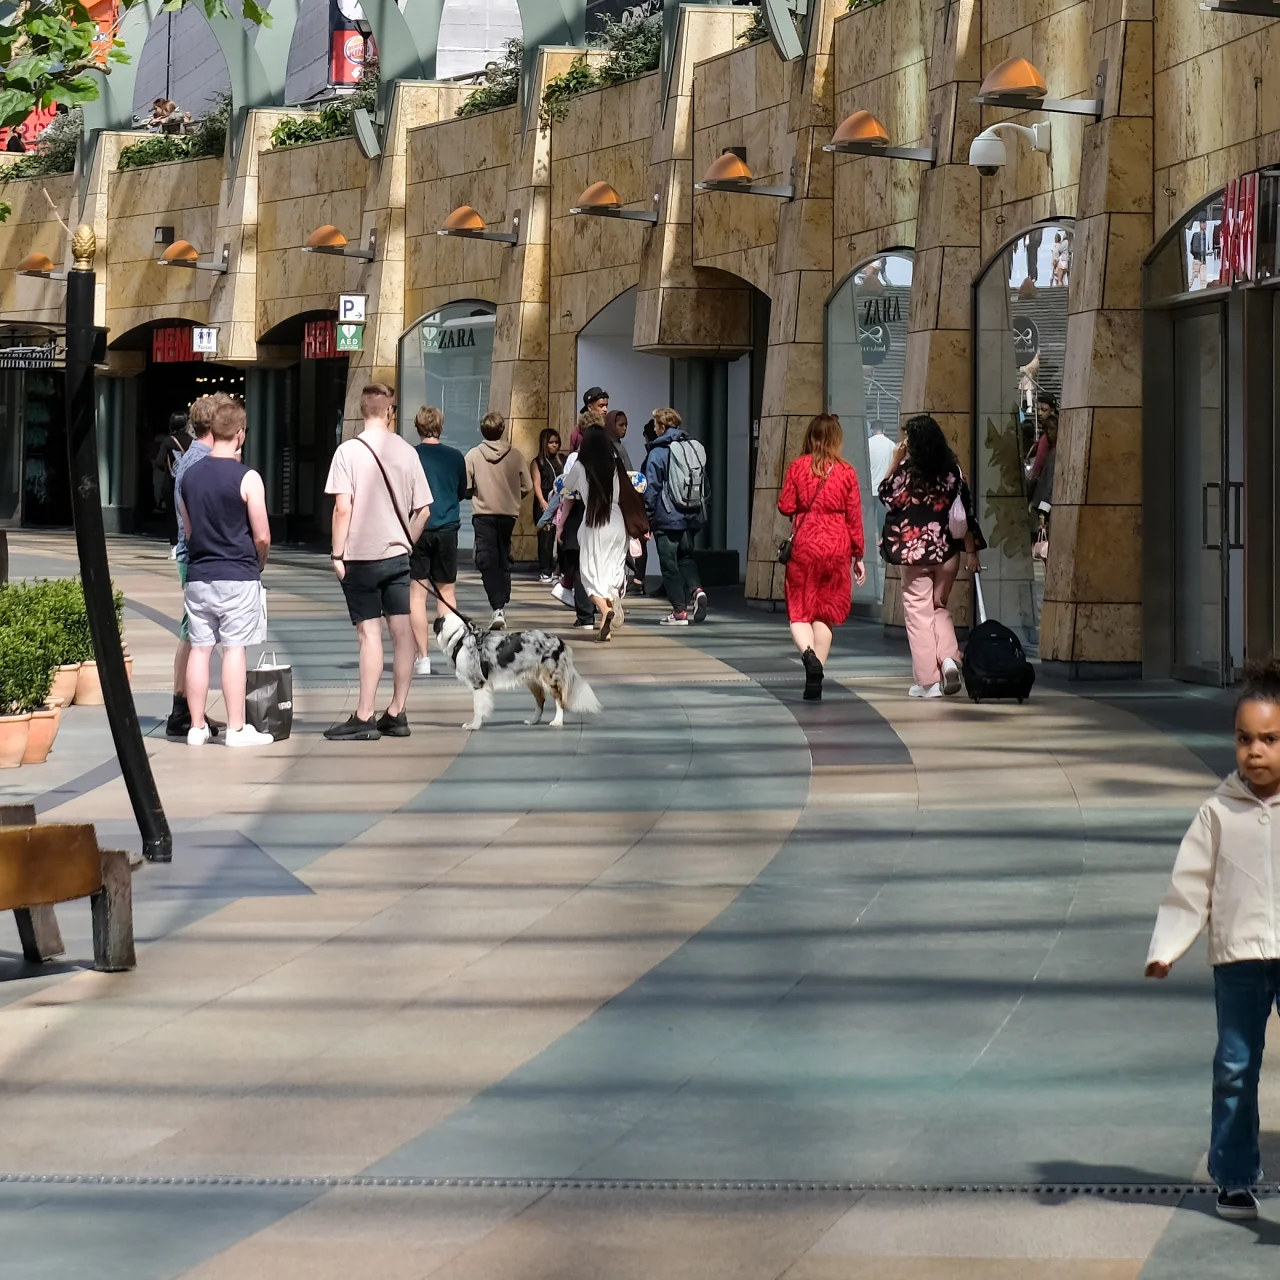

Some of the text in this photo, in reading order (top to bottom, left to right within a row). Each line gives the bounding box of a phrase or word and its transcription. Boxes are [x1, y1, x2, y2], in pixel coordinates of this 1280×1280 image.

[343, 300, 354, 318] P
[863, 295, 902, 326] ZARA
[153, 327, 204, 362] HEM
[438, 327, 476, 349] ZARA
